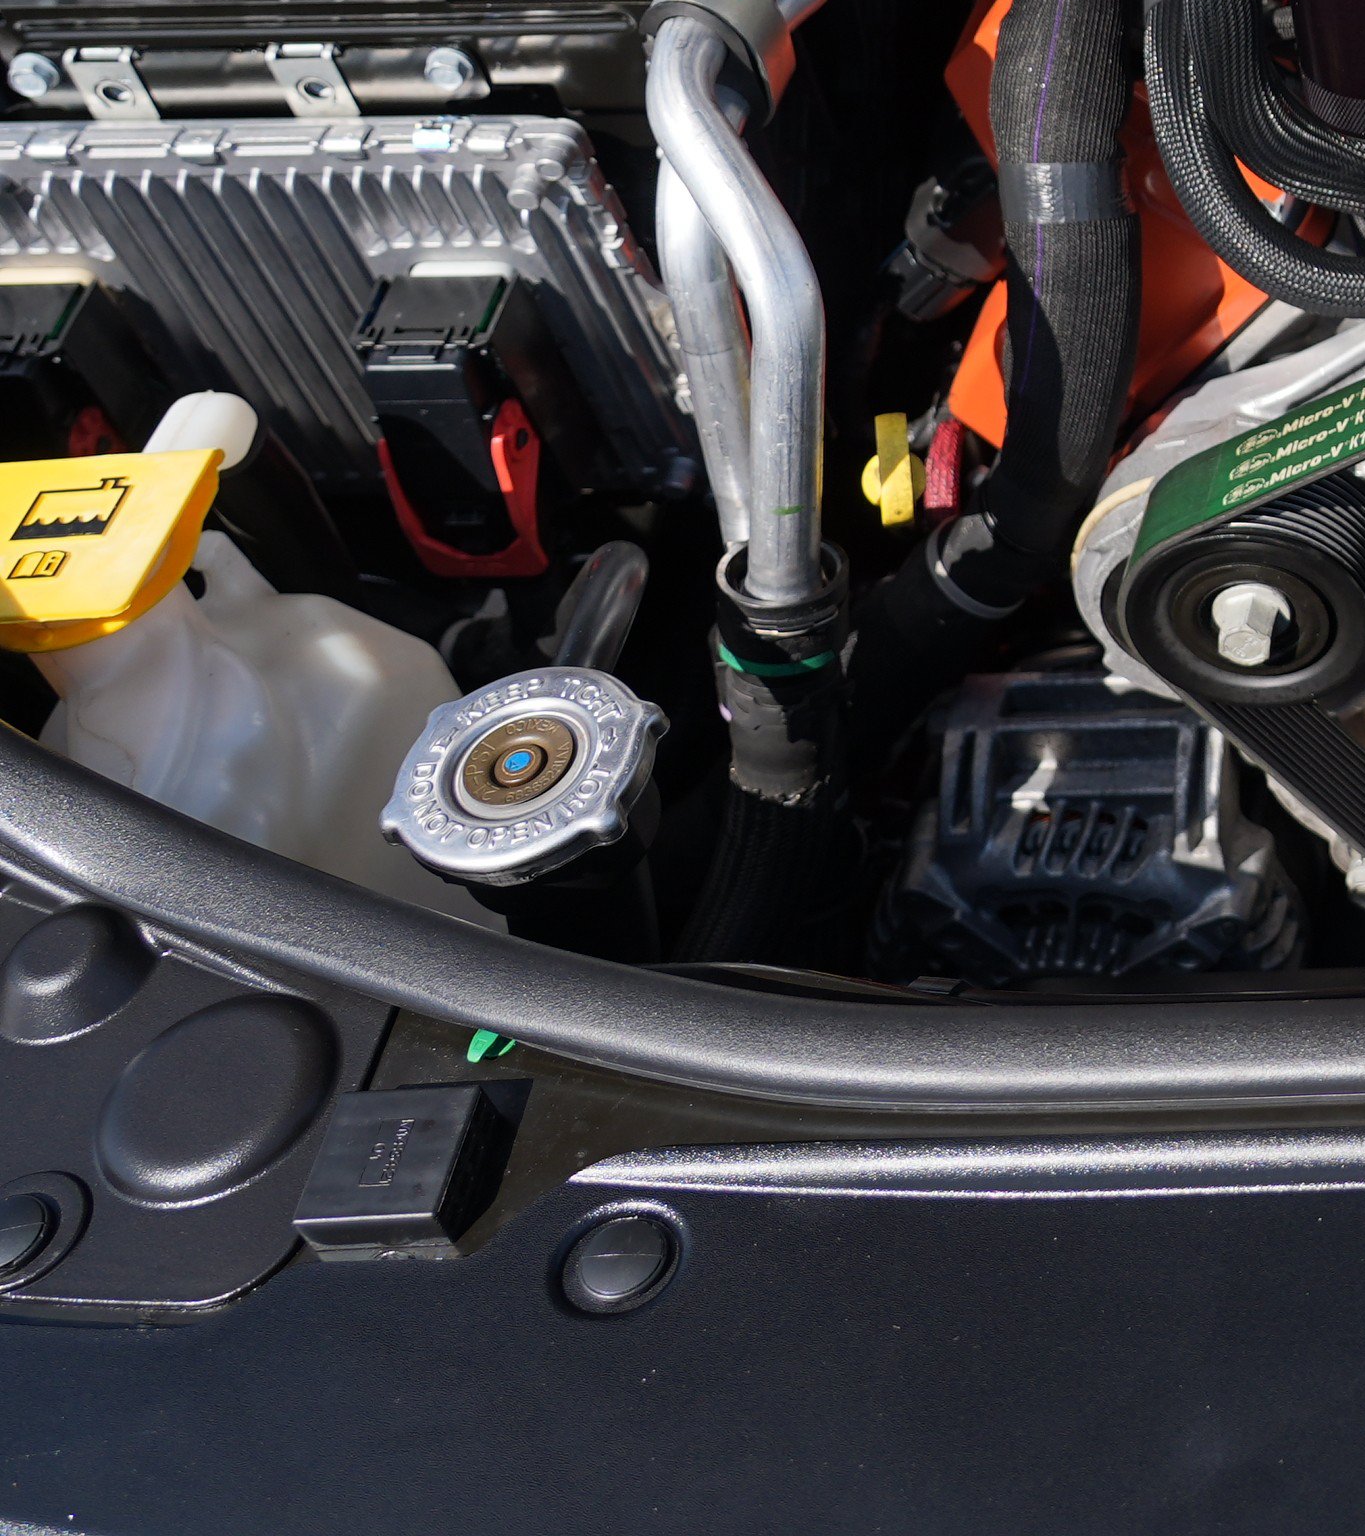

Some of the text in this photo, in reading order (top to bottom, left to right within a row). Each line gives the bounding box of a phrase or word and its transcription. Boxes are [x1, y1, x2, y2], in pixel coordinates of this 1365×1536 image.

[456, 678, 544, 725] KEEP
[408, 762, 611, 849] DO NOT OPEN HOT
